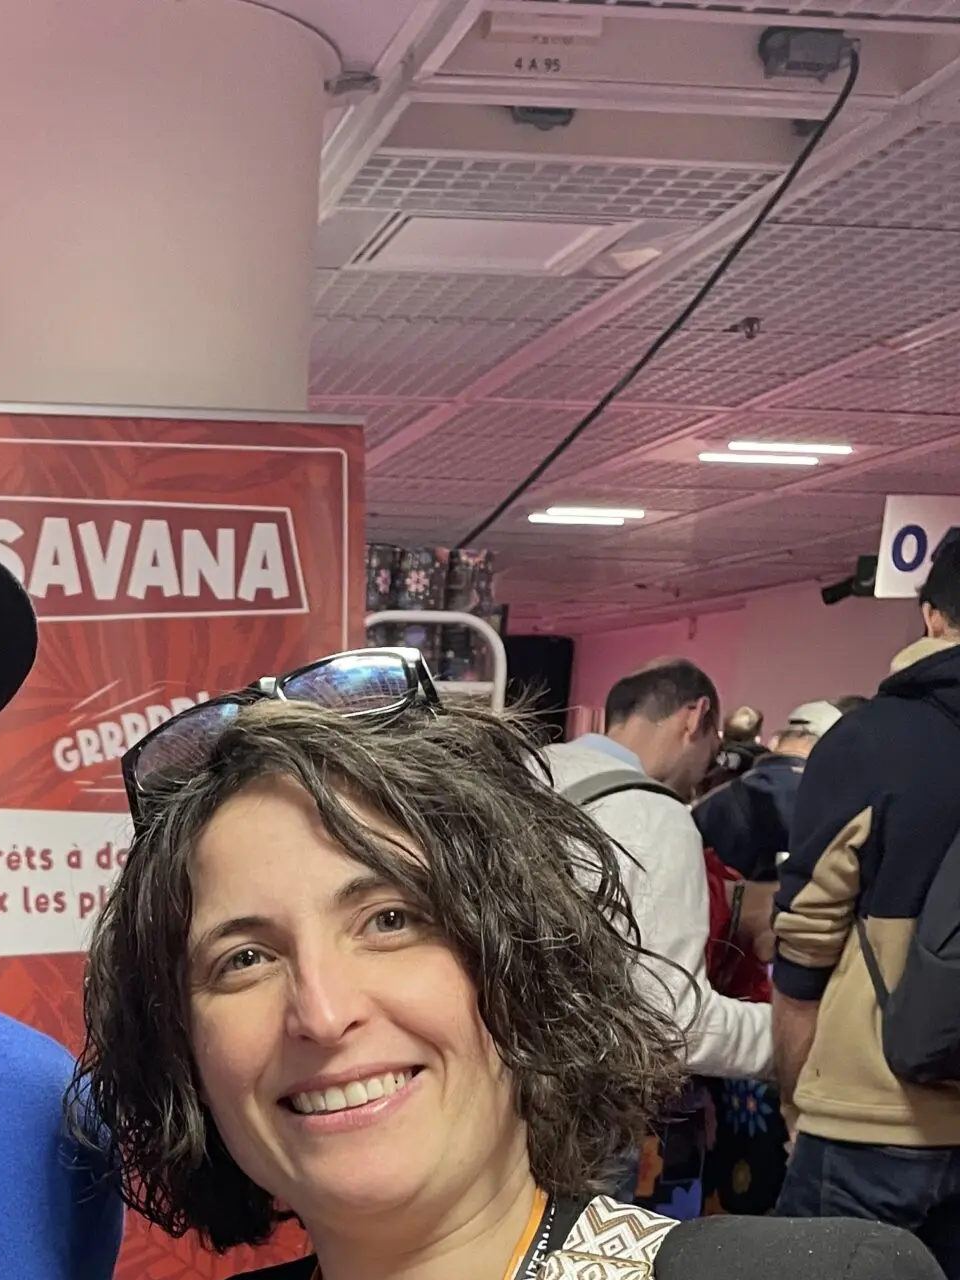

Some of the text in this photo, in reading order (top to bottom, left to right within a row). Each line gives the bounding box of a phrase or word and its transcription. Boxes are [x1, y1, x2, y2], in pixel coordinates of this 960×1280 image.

[514, 57, 561, 72] 4 A 95
[892, 524, 942, 572] 0
[67, 844, 82, 870] à
[23, 886, 67, 914] les
